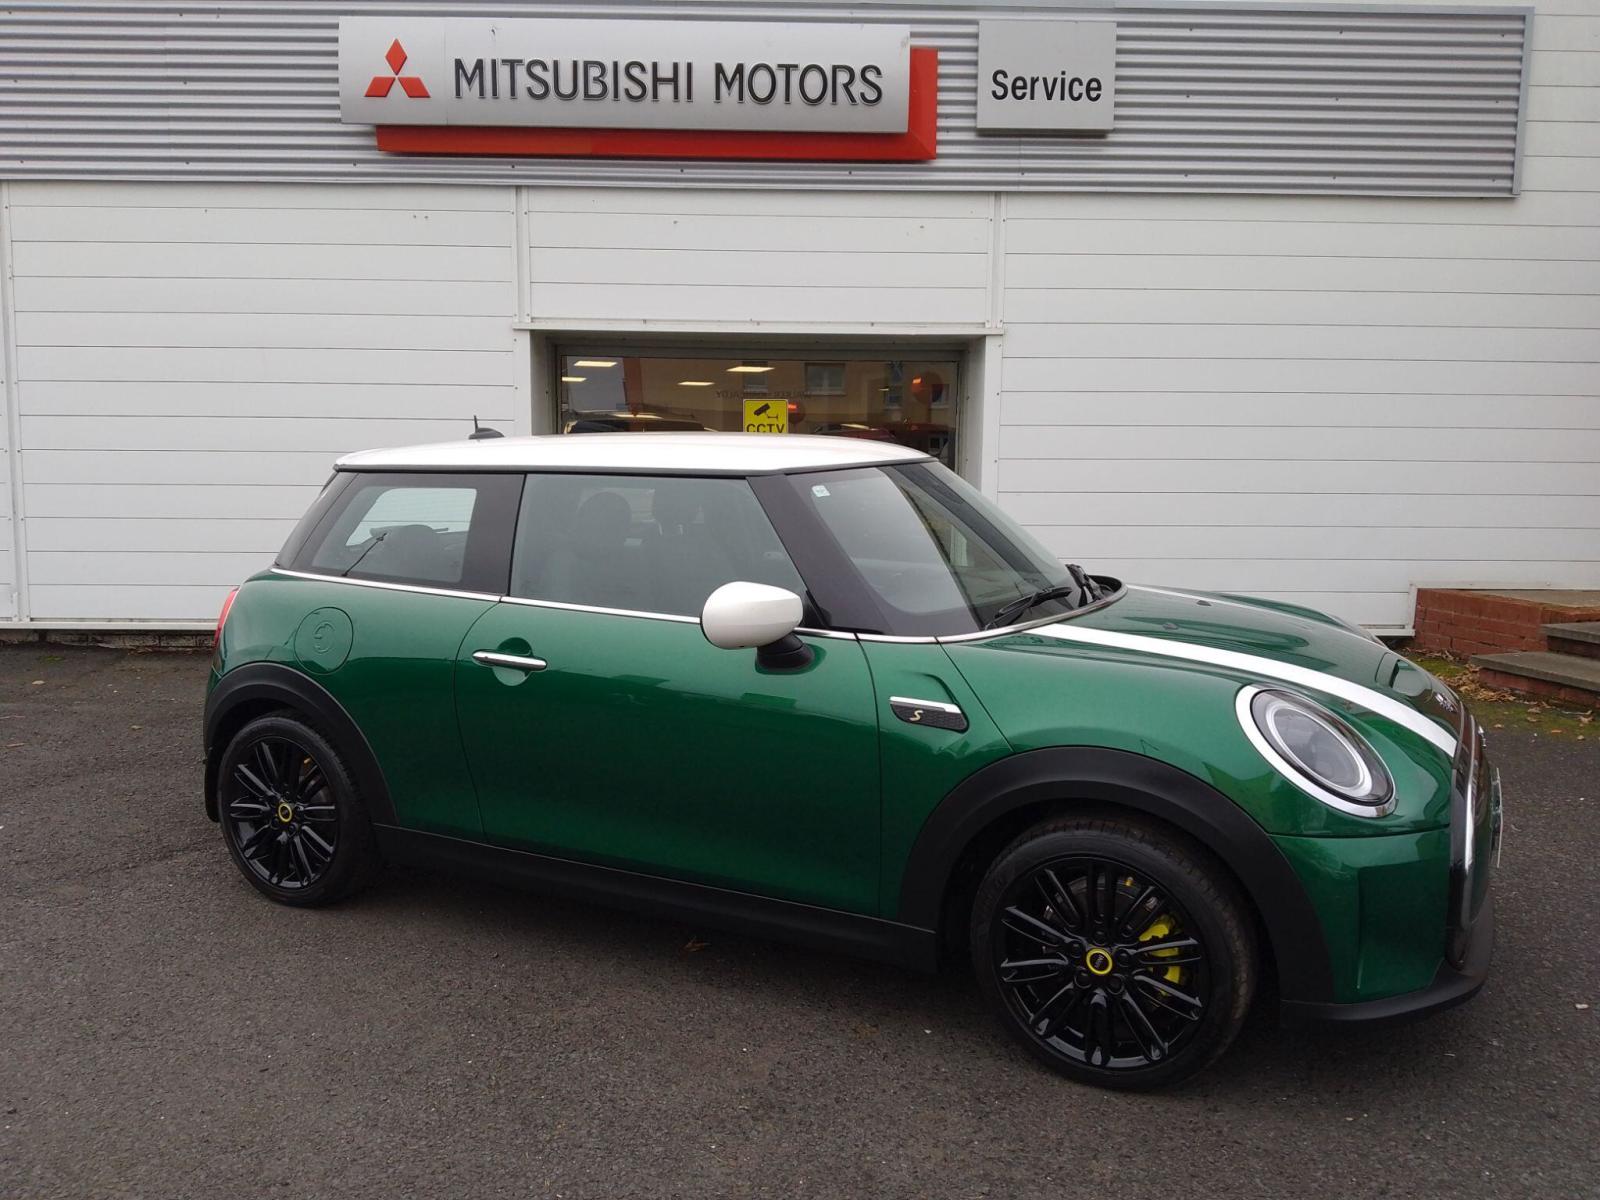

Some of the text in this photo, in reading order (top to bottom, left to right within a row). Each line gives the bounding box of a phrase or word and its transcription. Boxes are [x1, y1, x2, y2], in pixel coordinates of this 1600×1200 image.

[454, 58, 884, 105] MITSUBISHI MOTORS
[991, 69, 1103, 102] Service
[746, 423, 785, 433] CCTV
[910, 710, 924, 721] S
